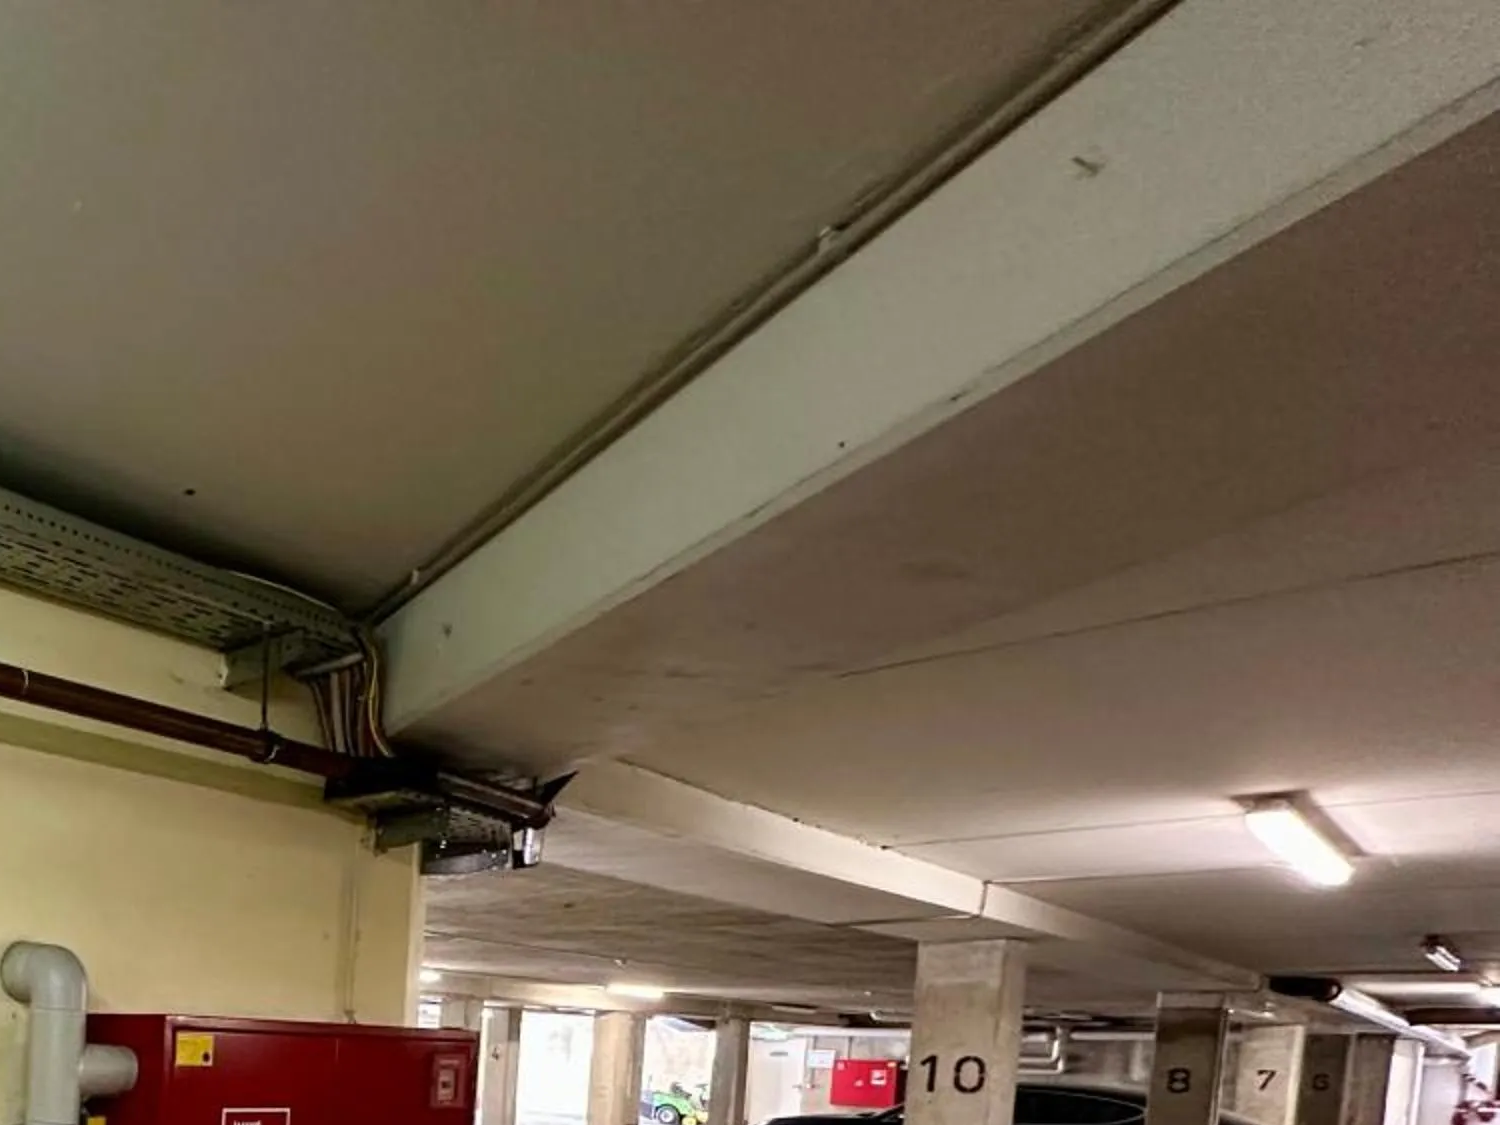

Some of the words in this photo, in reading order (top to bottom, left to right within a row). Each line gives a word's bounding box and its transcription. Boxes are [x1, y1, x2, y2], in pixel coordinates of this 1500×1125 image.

[920, 1055, 986, 1094] 10
[1167, 1067, 1191, 1094] 8
[1256, 1069, 1276, 1091] 7
